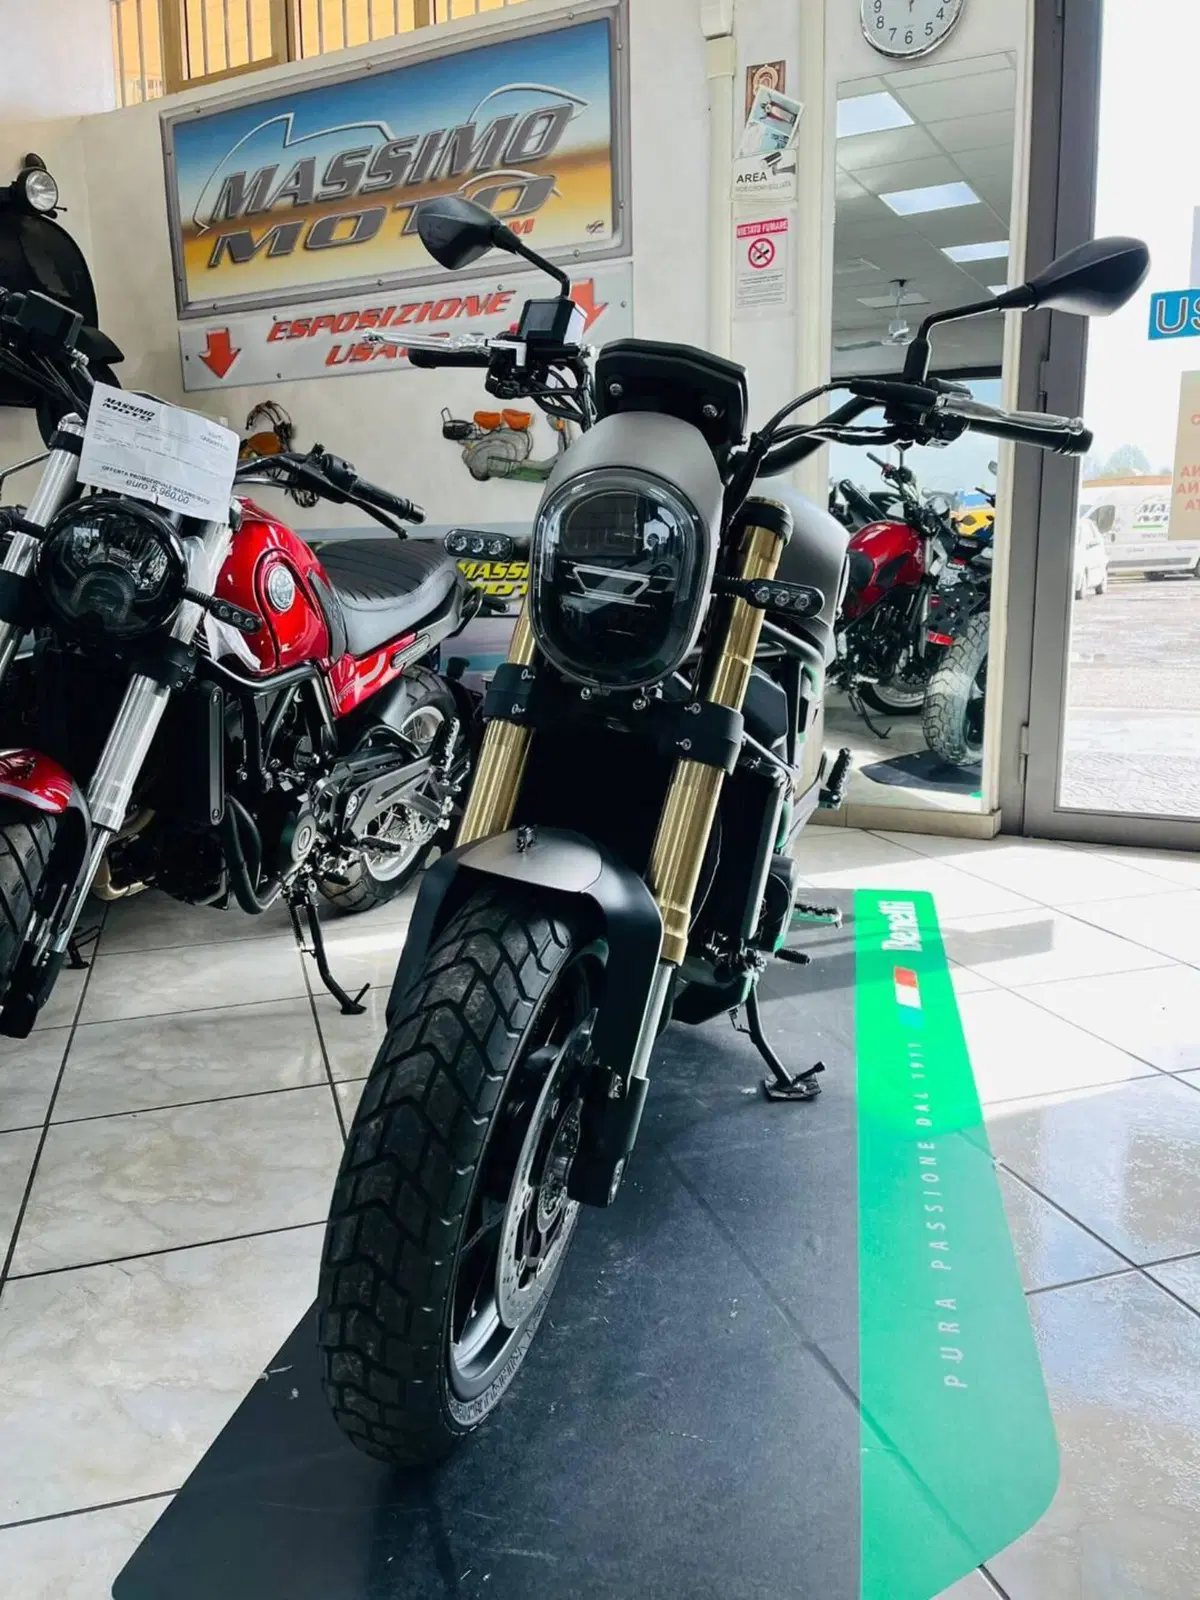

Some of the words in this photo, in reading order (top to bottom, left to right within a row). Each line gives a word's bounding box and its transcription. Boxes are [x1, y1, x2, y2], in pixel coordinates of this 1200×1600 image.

[936, 7, 945, 20] 4
[875, 15, 885, 29] 8
[924, 22, 934, 36] 5
[888, 27, 898, 41] 7
[904, 30, 913, 44] 6
[210, 102, 576, 222] MASSIMO
[736, 171, 768, 184] AREA
[267, 290, 518, 343] ESPOSIZIONE
[104, 397, 156, 418] MASSIMO
[126, 479, 149, 493] euro
[913, 1092, 932, 1127] DAL
[917, 1142, 952, 1270] PASSIONE
[935, 1298, 968, 1388] PURA
